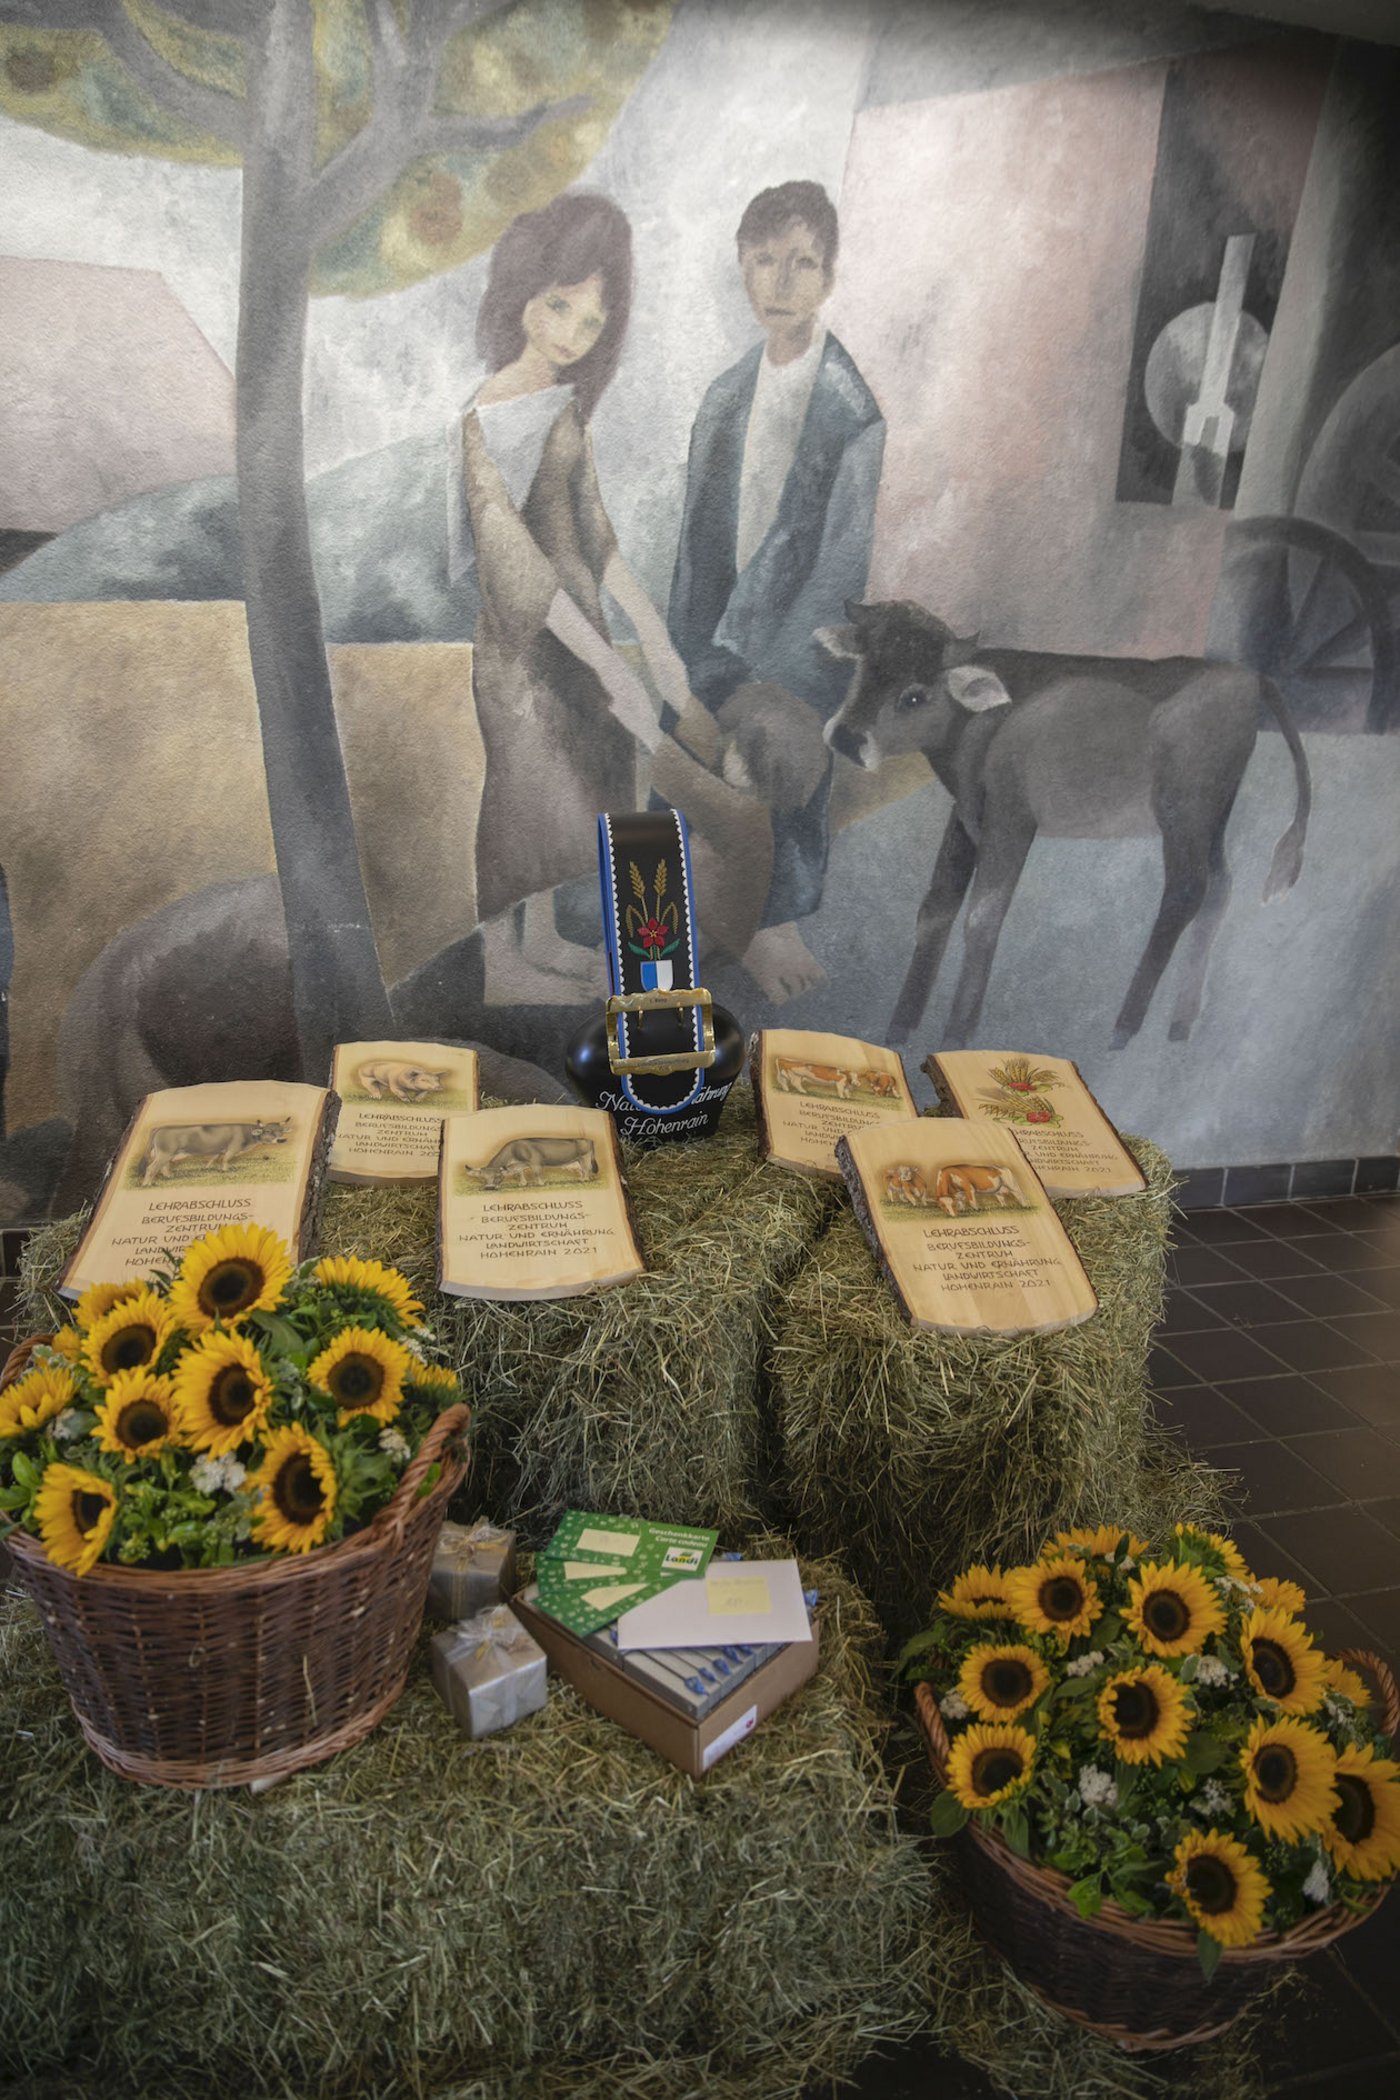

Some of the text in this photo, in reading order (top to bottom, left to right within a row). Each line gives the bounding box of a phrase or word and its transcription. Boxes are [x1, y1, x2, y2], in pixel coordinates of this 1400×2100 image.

[691, 1082, 733, 1104] ährung
[800, 1101, 880, 1119] LEHRABSCHLUSS
[620, 1111, 708, 1135] Hohenrain
[783, 1120, 818, 1130] NATUR
[377, 1129, 428, 1137] ZENTRUM
[348, 1147, 413, 1156] HOHENRAIN
[149, 1198, 251, 1211] LEHRABSCHLUSS
[483, 1200, 583, 1212] LEHRABSCHLUSS
[141, 1212, 254, 1225] BERUFSBILDUNGS-
[481, 1212, 592, 1224] BERUFSBILDUNGS-
[508, 1222, 567, 1231] ZENTRUM
[923, 1225, 1020, 1239] LEHRABSCHLUSS
[111, 1235, 157, 1246] NATUR
[163, 1234, 190, 1243] UND
[459, 1227, 615, 1241] NATUR UND ERNÄHRUNG
[486, 1238, 589, 1250] LANDWIRTSCHAFT
[927, 1239, 1032, 1251] BERUFSBILDUNGS-
[480, 1247, 598, 1259] HOHENRAIN 2021
[956, 1250, 1013, 1260] ZENTRUM
[912, 1257, 1063, 1272] NATUR UND ERNÄHRUNG
[943, 1269, 1039, 1281] LANDWIRTSCHAFT
[941, 1279, 1051, 1292] HOHENRAIN 2021
[649, 1528, 710, 1541] Geschenkkarte
[655, 1535, 677, 1544] Carte
[666, 1554, 699, 1565] Landi
